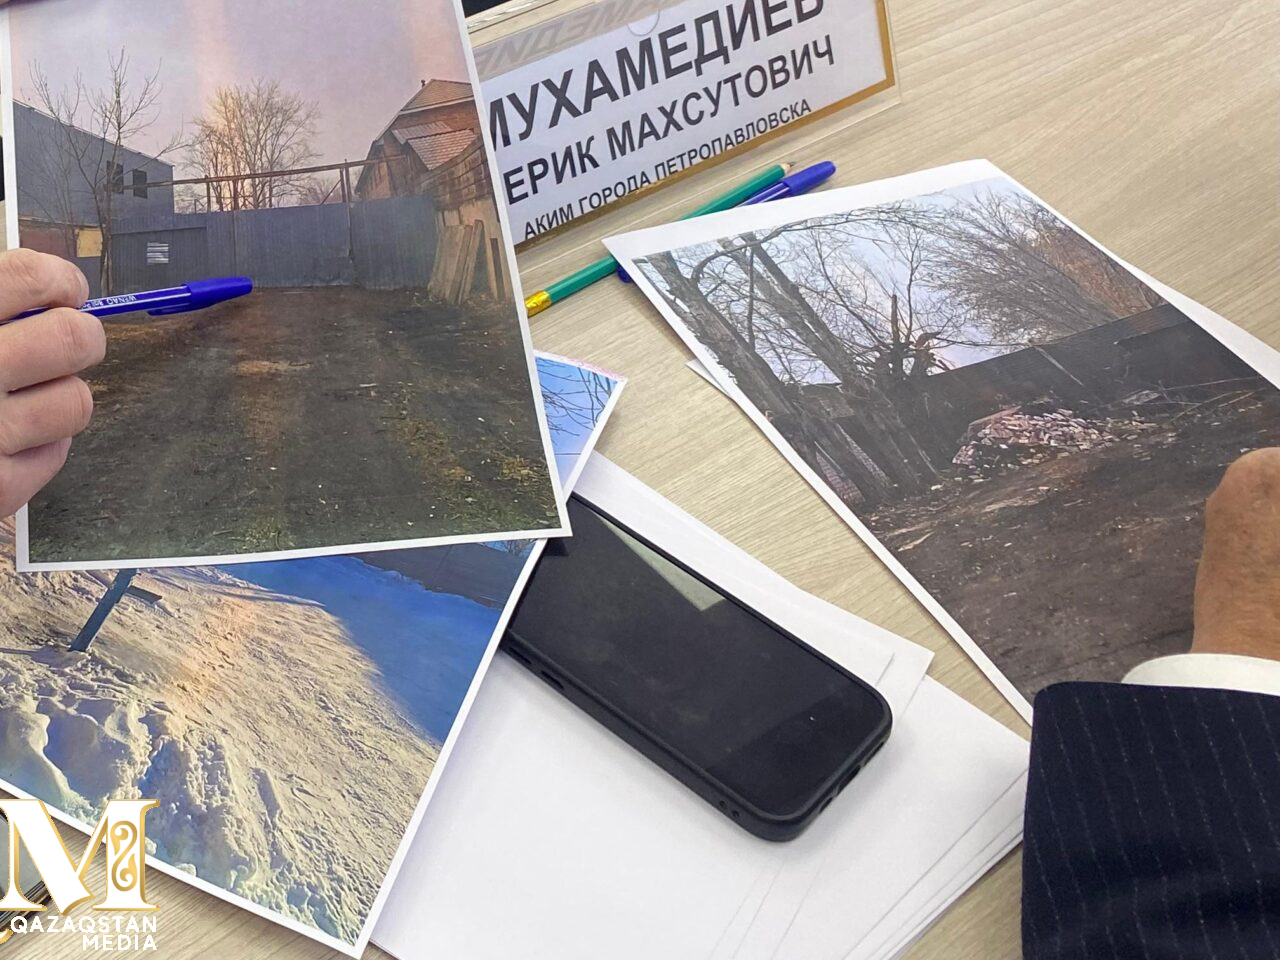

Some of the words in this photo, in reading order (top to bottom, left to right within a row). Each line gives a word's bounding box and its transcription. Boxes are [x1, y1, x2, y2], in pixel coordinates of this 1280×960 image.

[503, 135, 600, 205] ЕРИК
[606, 34, 835, 160] МАХСУТОВИЧ
[524, 203, 575, 240] АКИМ
[578, 170, 652, 215] ГОРОДА
[654, 98, 812, 181] ПЕТРОПАВЛОВСКА
